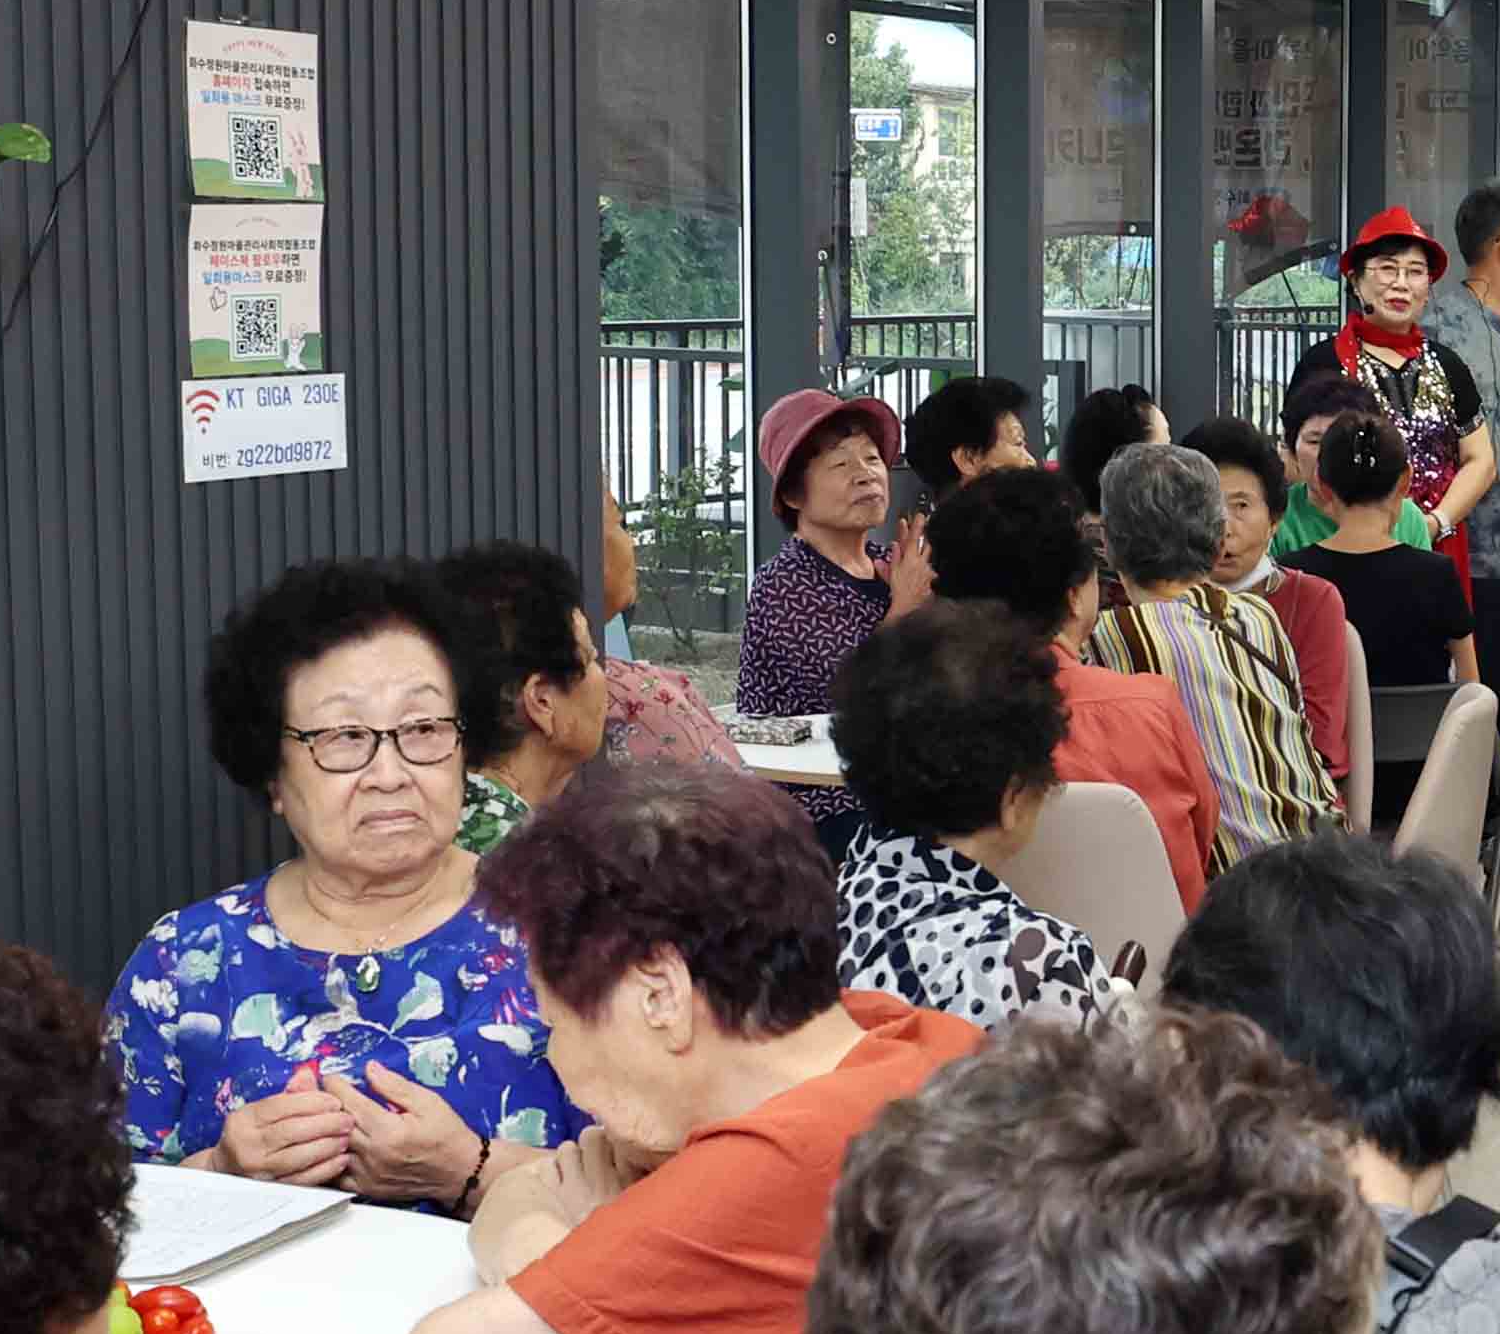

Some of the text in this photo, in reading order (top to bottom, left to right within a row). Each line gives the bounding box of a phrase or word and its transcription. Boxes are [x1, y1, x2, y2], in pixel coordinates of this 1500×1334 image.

[212, 74, 291, 93] 홈페이지 접속하면
[265, 95, 306, 111] 무료증정!
[211, 253, 249, 267] 페이스북
[265, 270, 307, 283] 무료증정!
[227, 388, 244, 409] KT
[257, 386, 292, 407] GIGA
[237, 440, 332, 467] zg22bd9872
